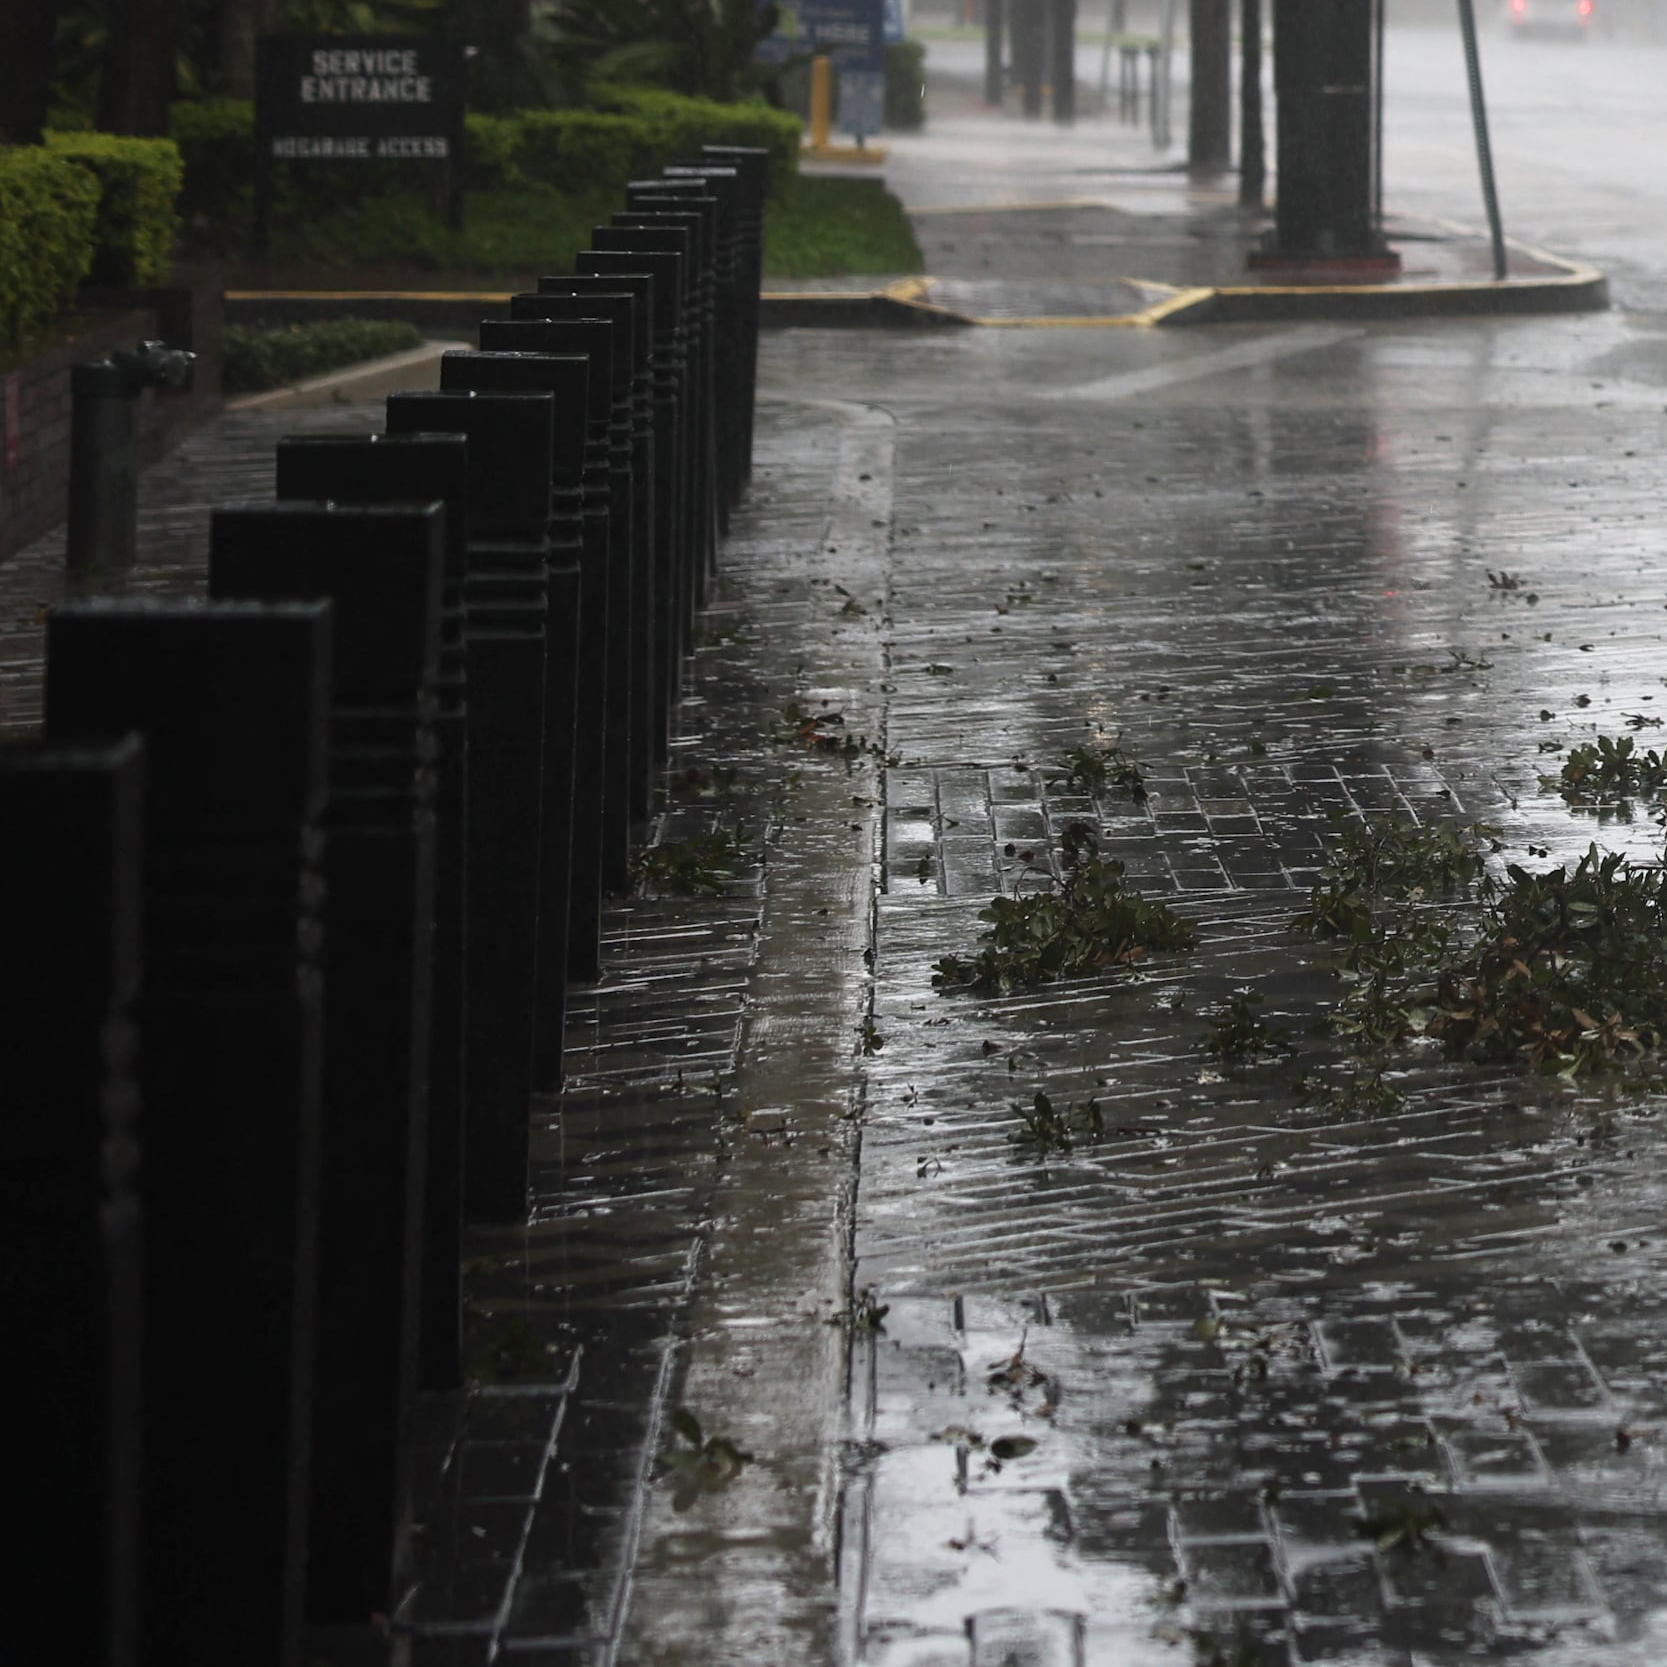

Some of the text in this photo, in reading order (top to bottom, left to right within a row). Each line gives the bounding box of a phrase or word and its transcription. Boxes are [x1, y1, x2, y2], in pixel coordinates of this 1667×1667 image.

[313, 49, 418, 76] SERVICE
[301, 76, 432, 103] ENTRANCE
[377, 136, 449, 158] ACCESS
